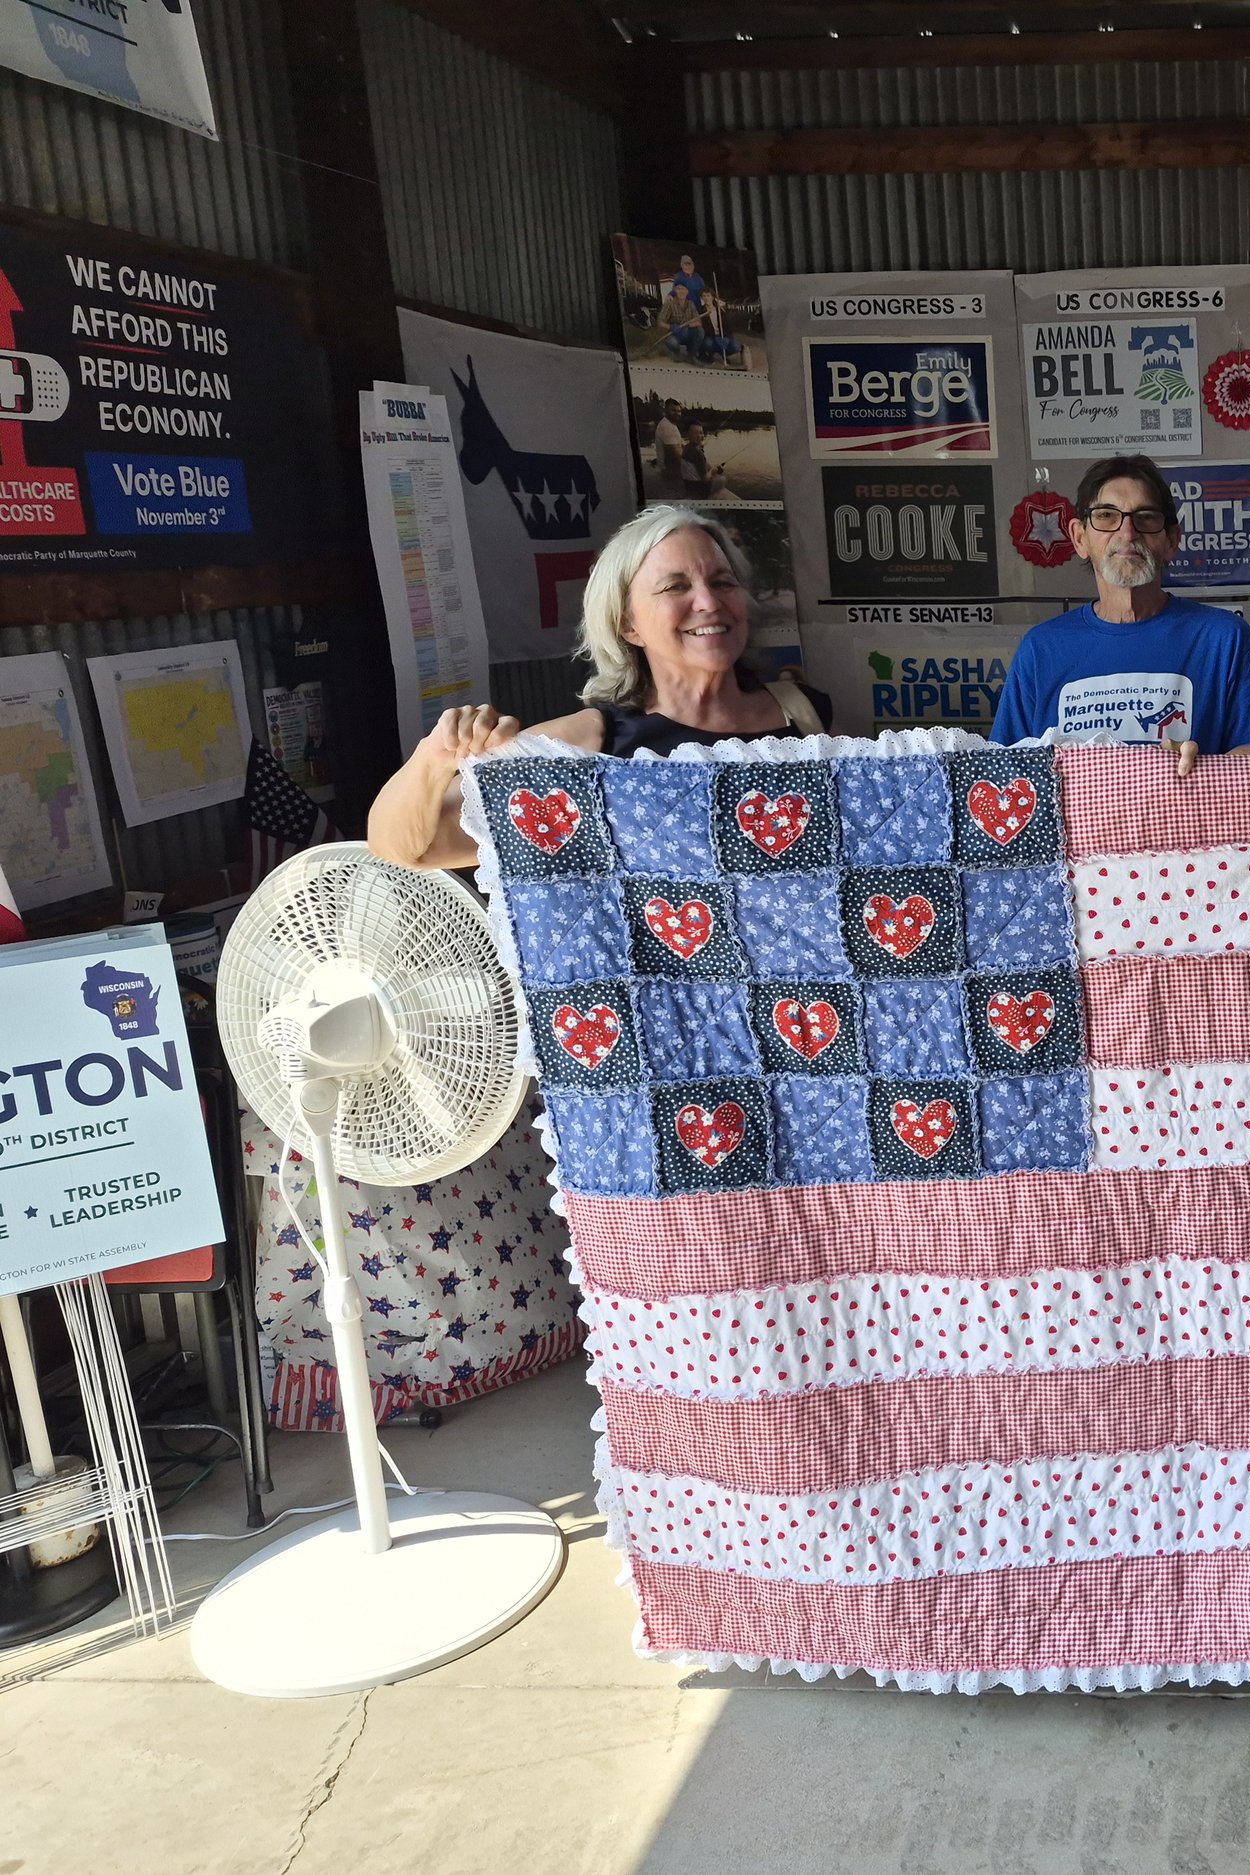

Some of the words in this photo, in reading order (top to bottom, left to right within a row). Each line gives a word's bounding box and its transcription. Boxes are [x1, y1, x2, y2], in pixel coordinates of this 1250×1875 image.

[48, 23, 91, 57] 1848
[66, 254, 113, 292] WE
[118, 265, 216, 311] CANNOT
[811, 300, 838, 317] US
[843, 298, 955, 316] CONGRESS
[971, 297, 983, 314] 3
[1057, 293, 1081, 311] US
[71, 305, 172, 347] AFFORD
[177, 321, 228, 356] THIS
[1035, 324, 1116, 350] AMANDA
[915, 352, 972, 377] Emily
[1032, 353, 1124, 398] BELL
[79, 356, 231, 400] REPUBLICAN
[826, 361, 970, 418] Berge
[99, 402, 230, 439] ECONOMY.
[829, 409, 850, 419] FOR
[851, 408, 907, 418] CONGRESS
[1039, 400, 1064, 421] For
[1069, 398, 1119, 423] Congress
[1038, 437, 1067, 446] CANDIDATE
[1069, 437, 1080, 446] FOR
[1080, 436, 1115, 445] WISCONSIN'S
[1124, 435, 1167, 444] CONGRESSIONAL
[1168, 433, 1192, 442] DISTRICT
[0, 481, 75, 500] LTHCARE
[112, 463, 175, 496] Vote
[178, 466, 229, 497] Blue
[856, 484, 960, 498] REBECCA
[1169, 481, 1203, 500] AD
[0, 504, 55, 522] COSTS
[136, 507, 207, 525] November
[208, 506, 226, 525] 3rd
[834, 504, 988, 563] COOKE
[34, 551, 57, 562] Party
[59, 550, 67, 559] of
[68, 549, 108, 560] Marquette
[109, 548, 137, 559] County
[888, 564, 954, 573] CONGRESS
[848, 607, 902, 624] STATE
[909, 606, 993, 623] SENATE-13
[901, 657, 1008, 683] SASHA
[872, 684, 1003, 718] RIPLEY
[1065, 694, 1082, 703] The
[1083, 687, 1140, 699] Democratic
[1142, 686, 1170, 696] Party
[1172, 688, 1181, 696] of
[1064, 699, 1154, 719] Marquette
[1063, 716, 1123, 734] County
[98, 979, 145, 995] WISCONSIN
[118, 1020, 139, 1032] 1848
[30, 1117, 129, 1150] DISTRICT
[64, 1170, 161, 1203] TRUSTED
[49, 1187, 182, 1229] LEADERSHIP
[30, 1263, 51, 1275] FOR
[52, 1259, 66, 1269] WI
[68, 1252, 97, 1265] STATE
[98, 1241, 148, 1258] ASSEMBLY
